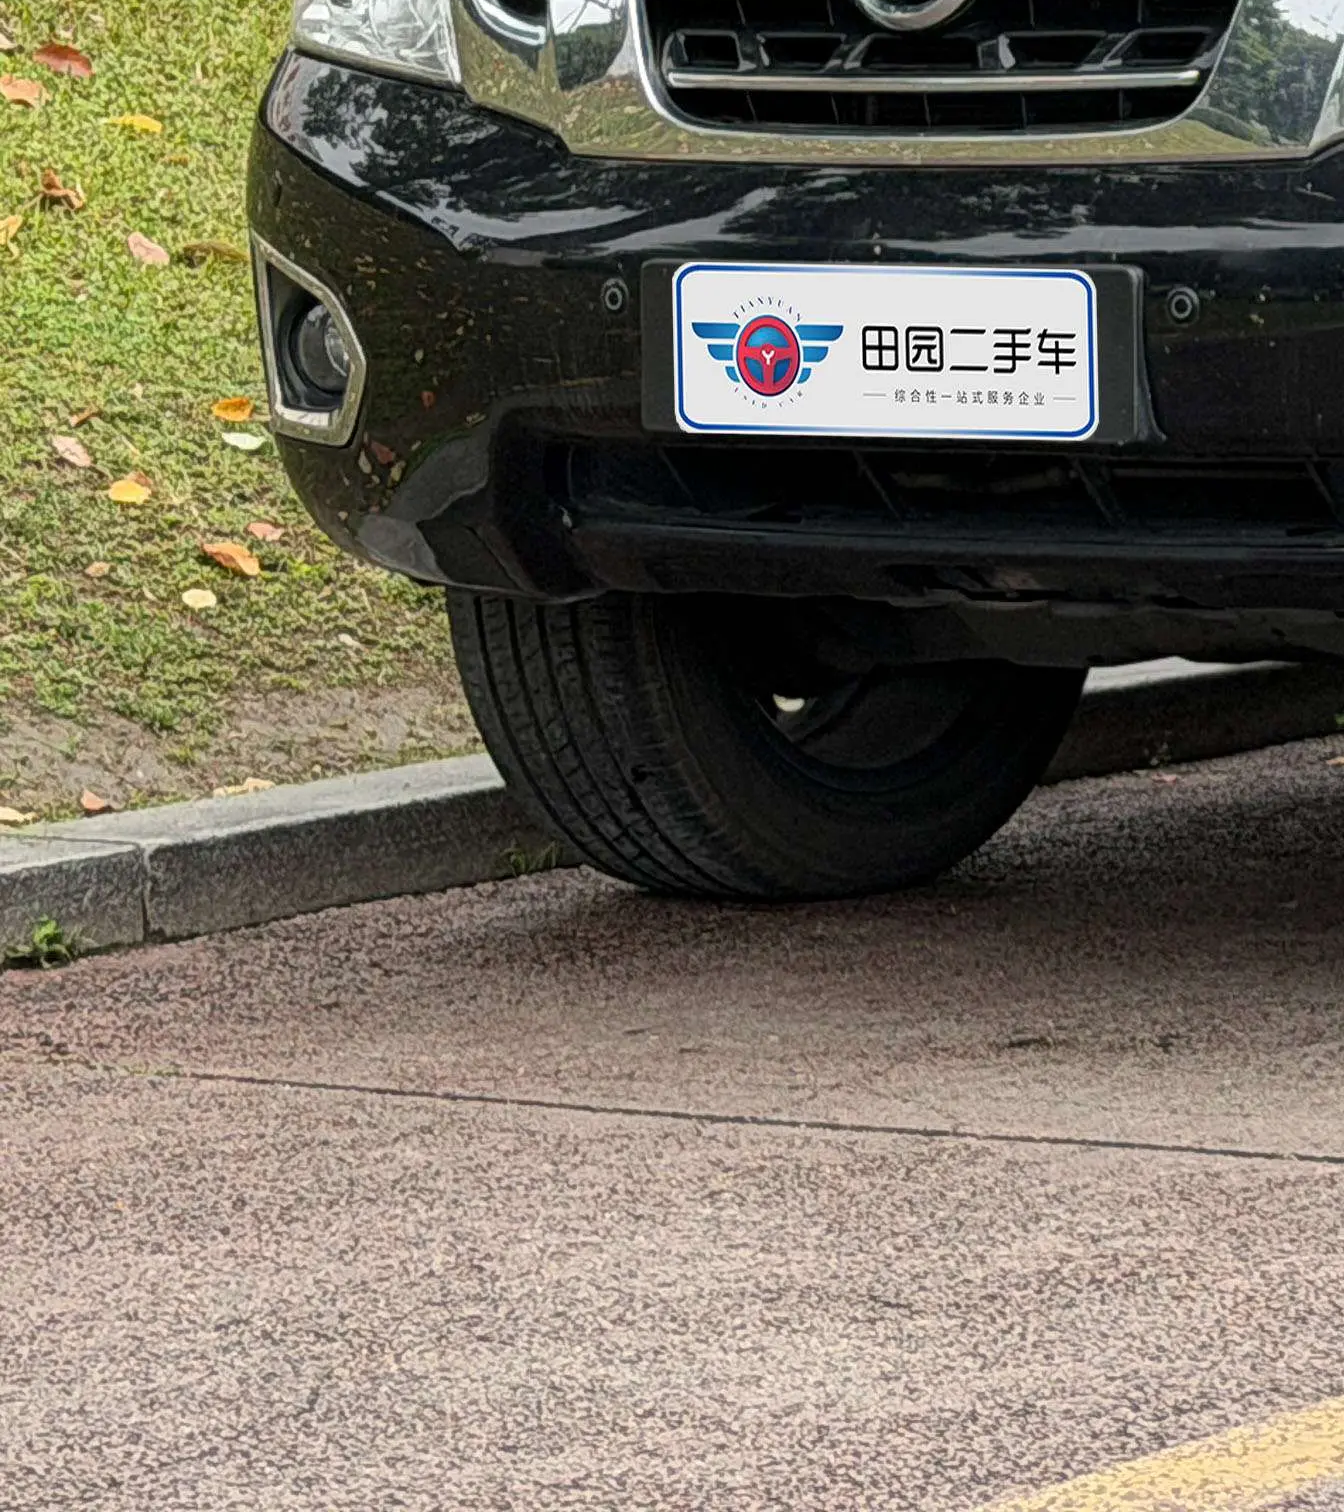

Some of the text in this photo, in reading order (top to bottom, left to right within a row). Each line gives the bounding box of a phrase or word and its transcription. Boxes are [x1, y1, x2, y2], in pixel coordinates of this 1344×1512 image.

[861, 325, 1077, 375] 田园二手车
[893, 388, 1046, 406] 综合性一站式服务企业
